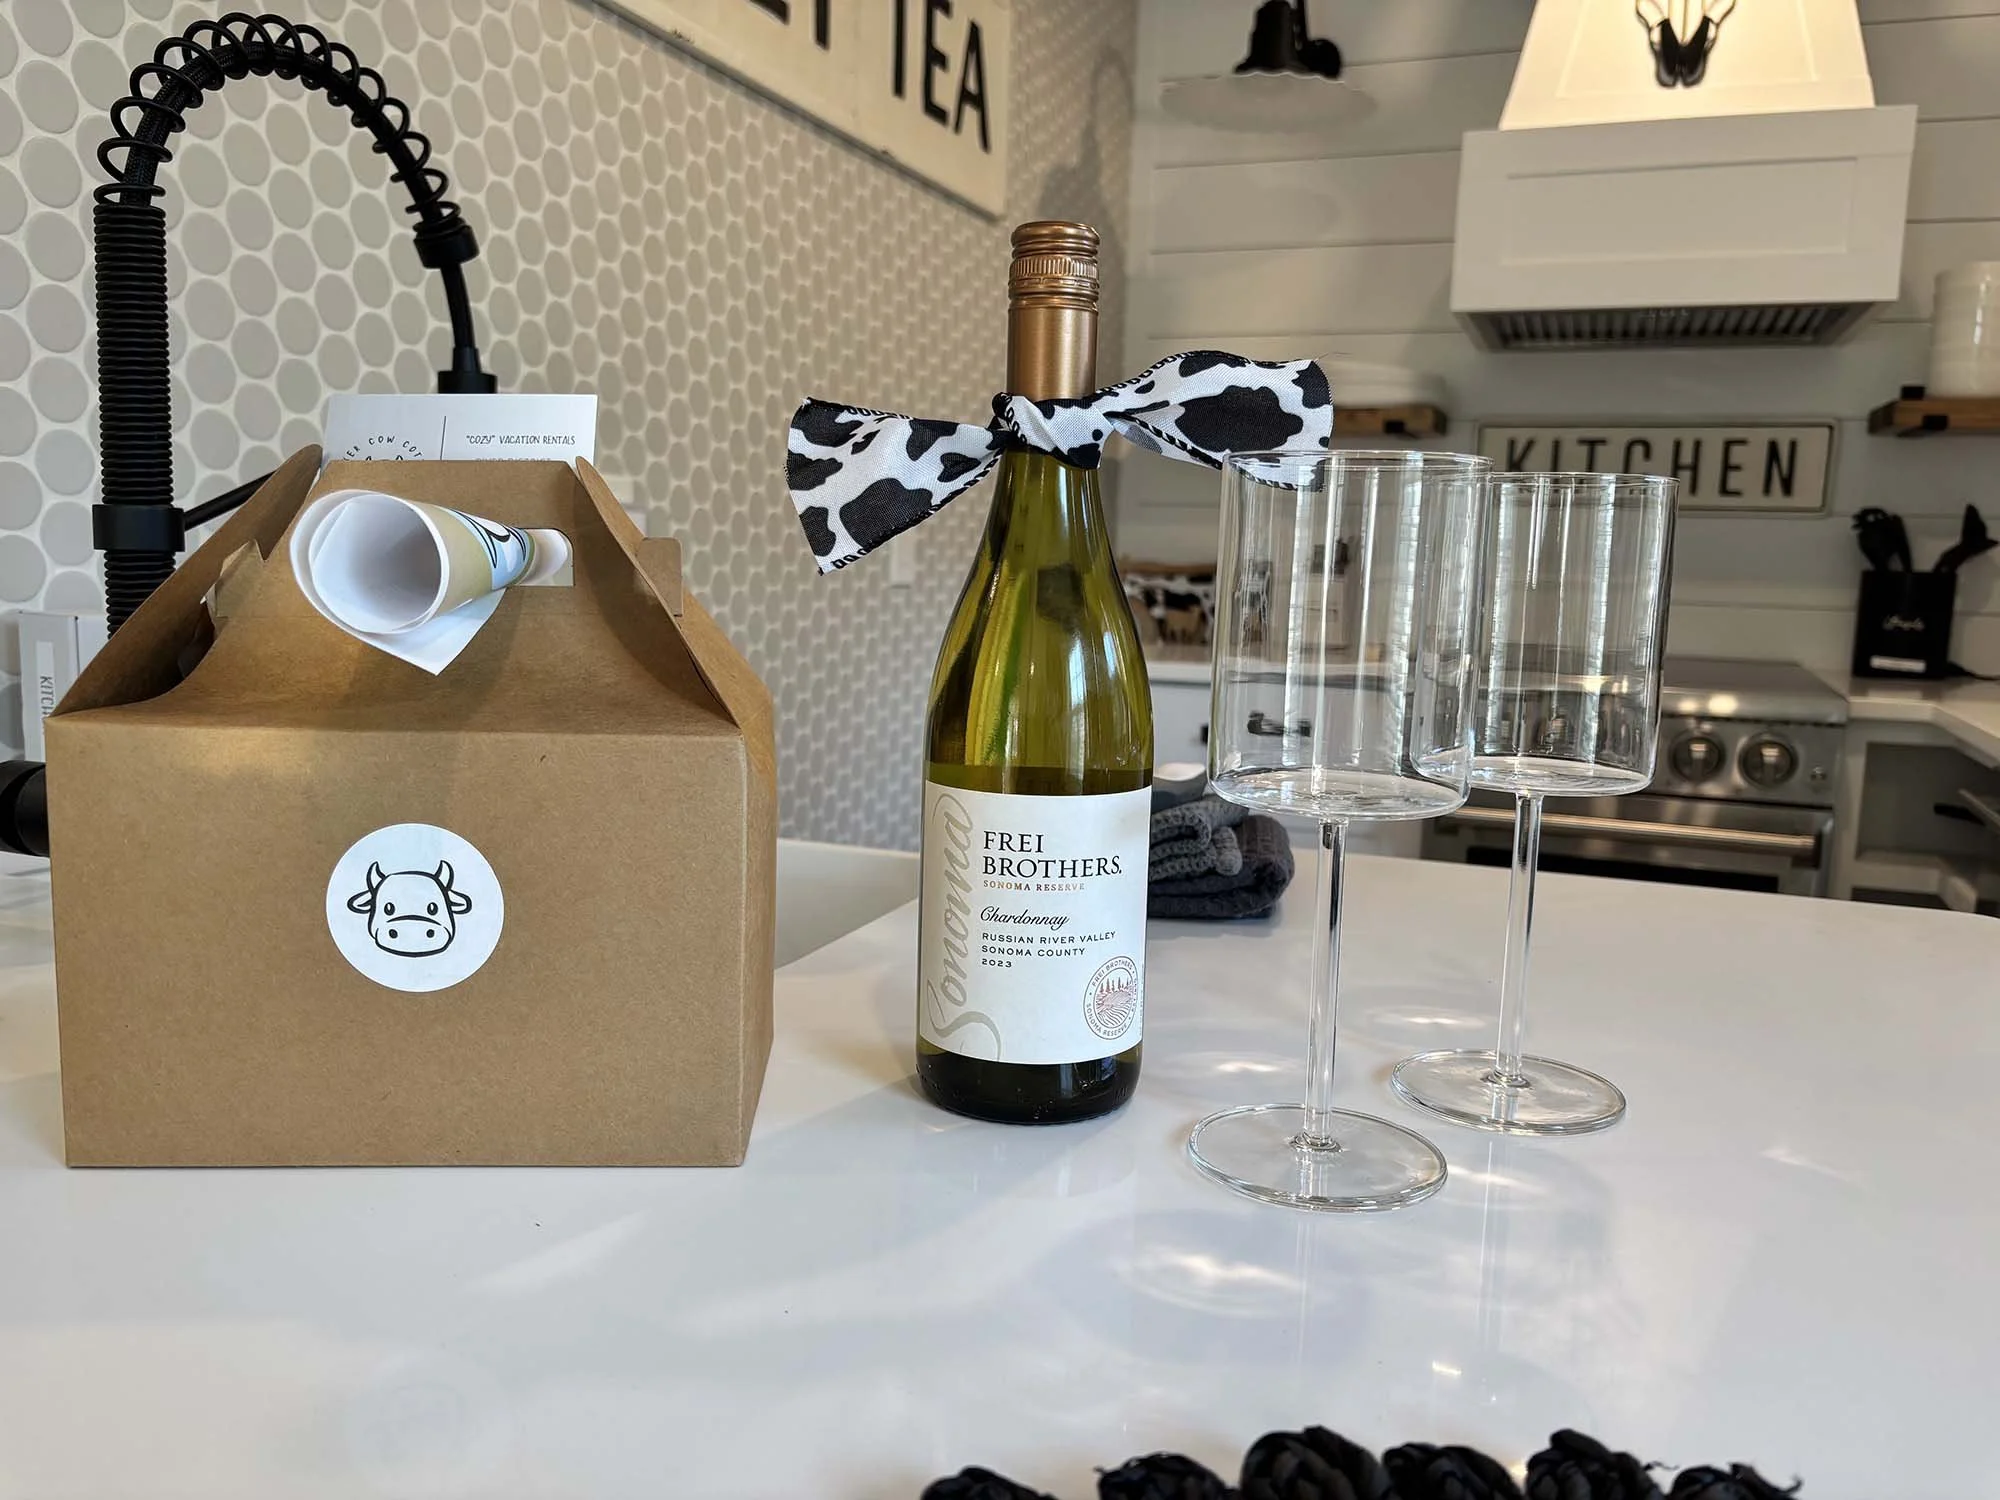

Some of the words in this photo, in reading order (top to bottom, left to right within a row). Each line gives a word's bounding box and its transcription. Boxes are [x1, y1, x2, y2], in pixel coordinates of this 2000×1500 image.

[368, 435, 396, 446] COW
[402, 440, 423, 458] COT
[499, 434, 541, 446] VACATION
[542, 434, 576, 446] RENTALS
[1506, 437, 1798, 498] KITCHEN
[40, 676, 55, 717] KITCH
[983, 830, 1045, 853] FREI
[983, 880, 1031, 891] SONOMA
[1036, 883, 1085, 892] RESERVE
[926, 792, 1001, 1062] Sonoma
[980, 905, 1070, 931] Chardonnay
[982, 932, 1034, 944] RUSSIAN
[1039, 936, 1075, 945] RIVER
[1079, 931, 1116, 943] VALLEY
[981, 945, 1032, 957] SONOMA
[1037, 948, 1085, 957] COUNTY
[981, 958, 1012, 968] 2023
[1091, 969, 1106, 987] FREI
[1105, 959, 1133, 971] BROTHERS
[1086, 1003, 1102, 1034] SONOMA
[1102, 1024, 1128, 1037] RESERVE
